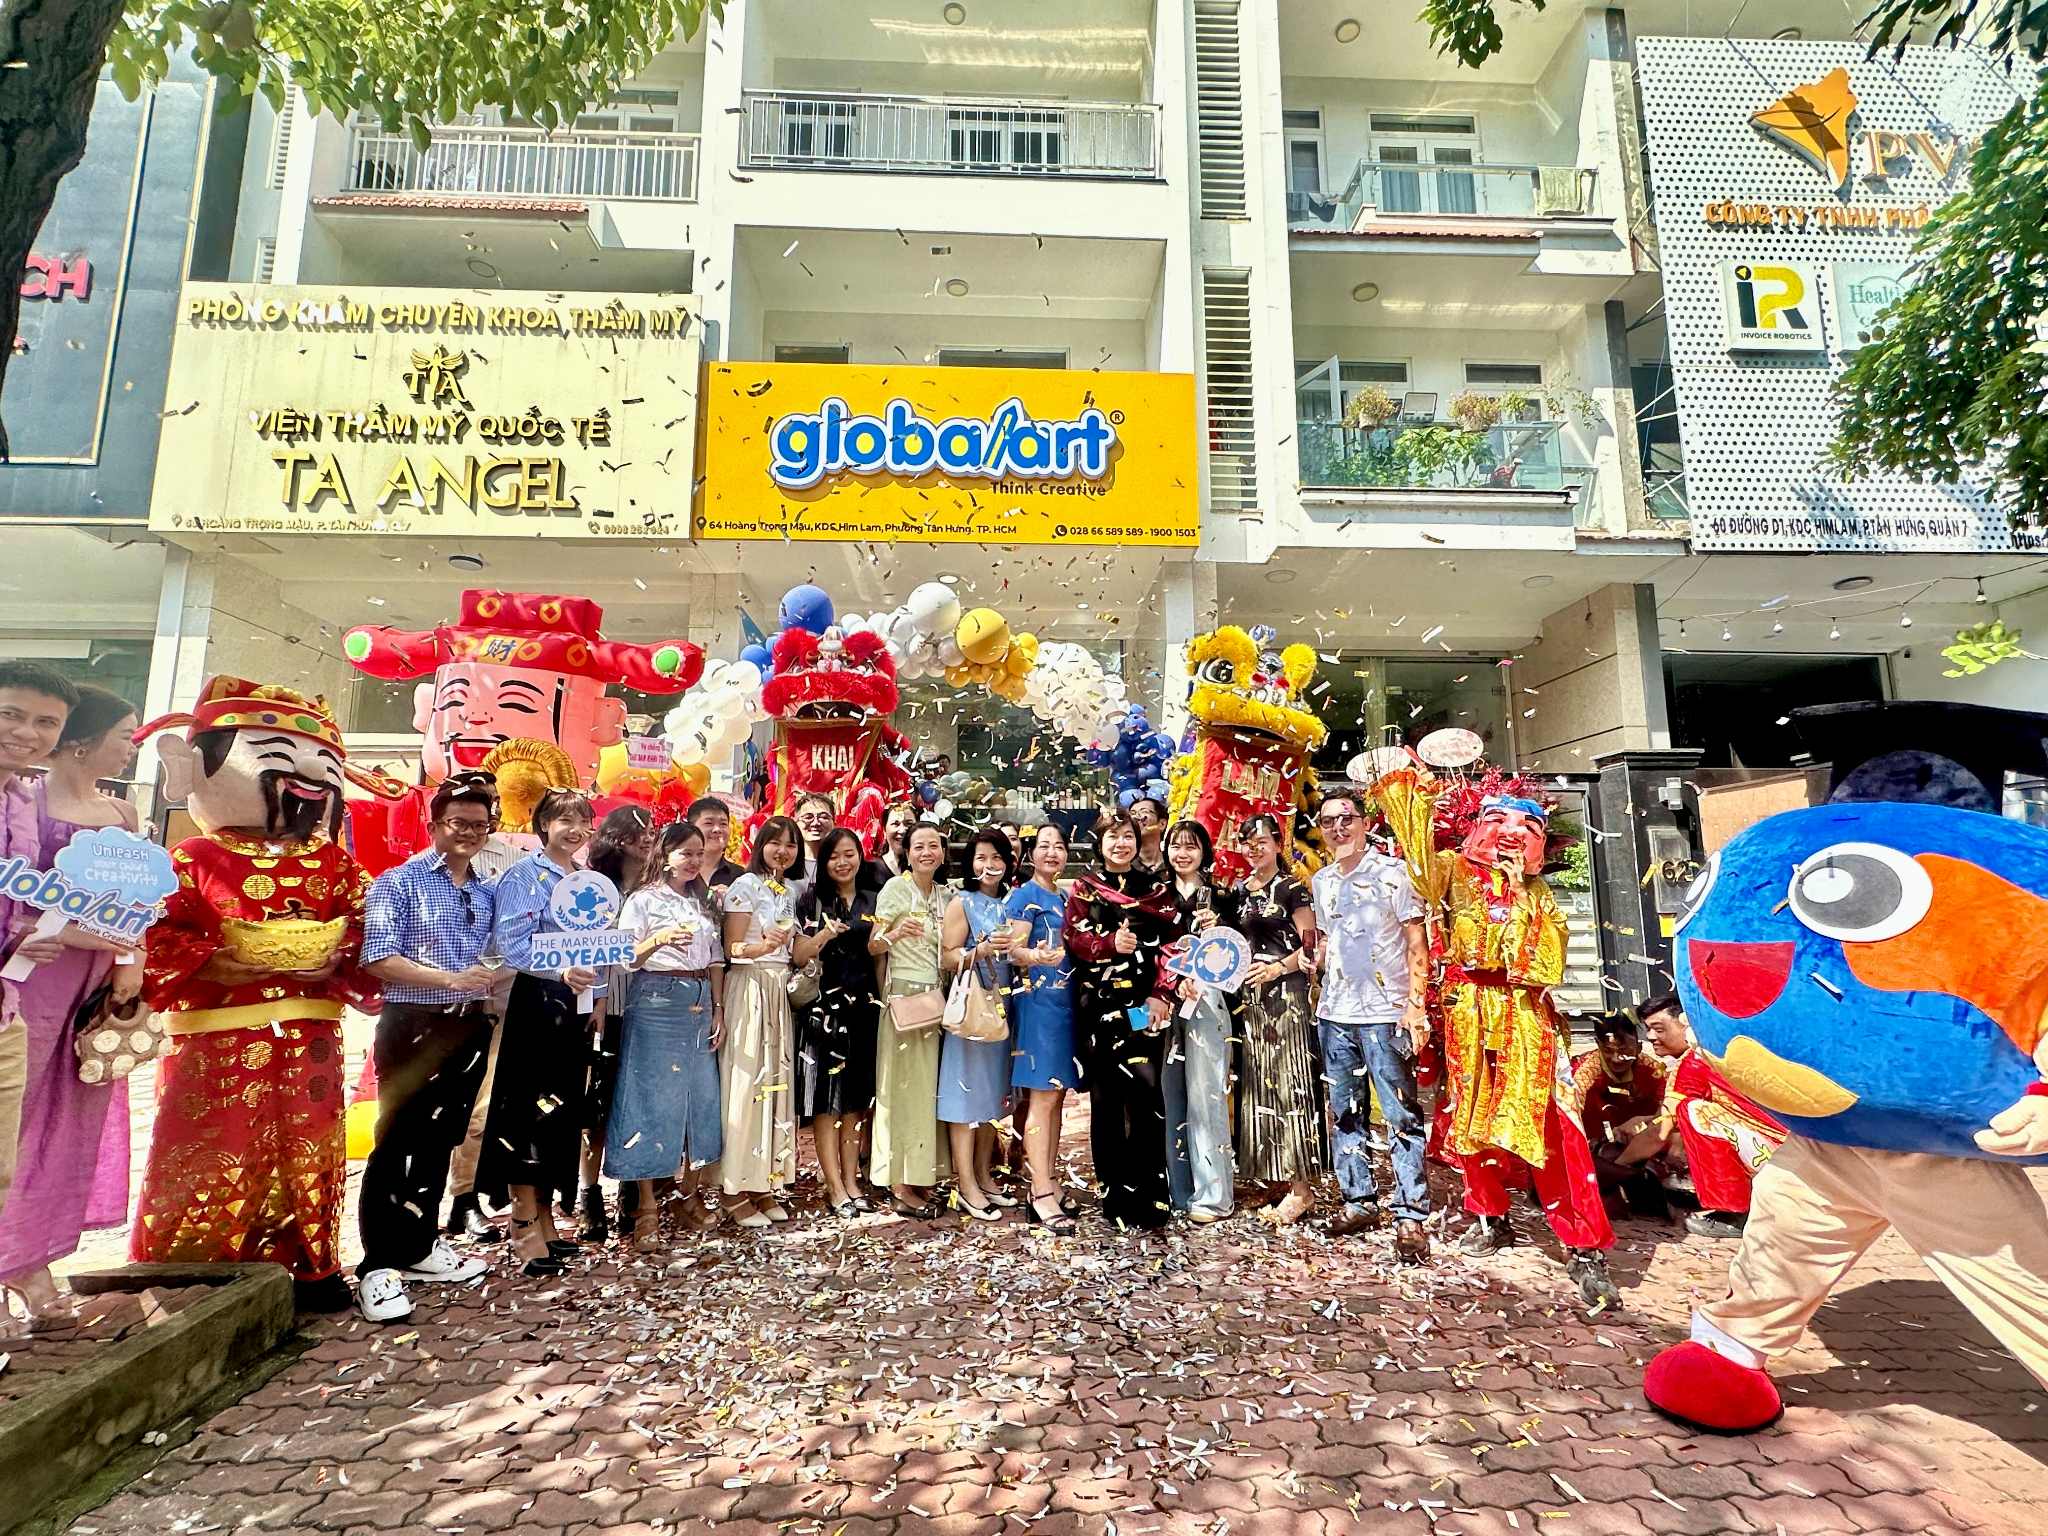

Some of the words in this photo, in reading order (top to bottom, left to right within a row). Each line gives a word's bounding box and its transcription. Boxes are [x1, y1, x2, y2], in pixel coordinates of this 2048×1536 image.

[1706, 199, 1772, 225] CÔNG
[1776, 205, 1806, 225] TY
[1812, 206, 1878, 226] TNHH
[190, 291, 285, 323] PHÒNG
[379, 298, 479, 328] CHUYÊN
[487, 306, 560, 330] KHOA
[1773, 332, 1813, 340] ROBOTICS
[773, 400, 1113, 483] globalart
[271, 449, 351, 505] TA
[377, 454, 577, 509] ANGEL
[991, 481, 1033, 495] Think
[1039, 482, 1106, 497] Creative
[709, 521, 722, 530] 64
[725, 520, 757, 532] Hoàng
[927, 524, 943, 533] Tân
[994, 525, 1017, 534] HCM
[1070, 526, 1089, 536] 028
[1091, 527, 1103, 536] 66
[1105, 527, 1124, 536] 589
[1126, 528, 1144, 536] 589
[1150, 528, 1173, 537] 1900
[1175, 528, 1196, 537] 1503
[0, 857, 155, 936] lobalart
[79, 922, 101, 936] Think
[534, 939, 558, 950] THE
[561, 934, 635, 949] MARVELOUS
[533, 950, 562, 970] 20
[565, 945, 636, 966] YEARS
